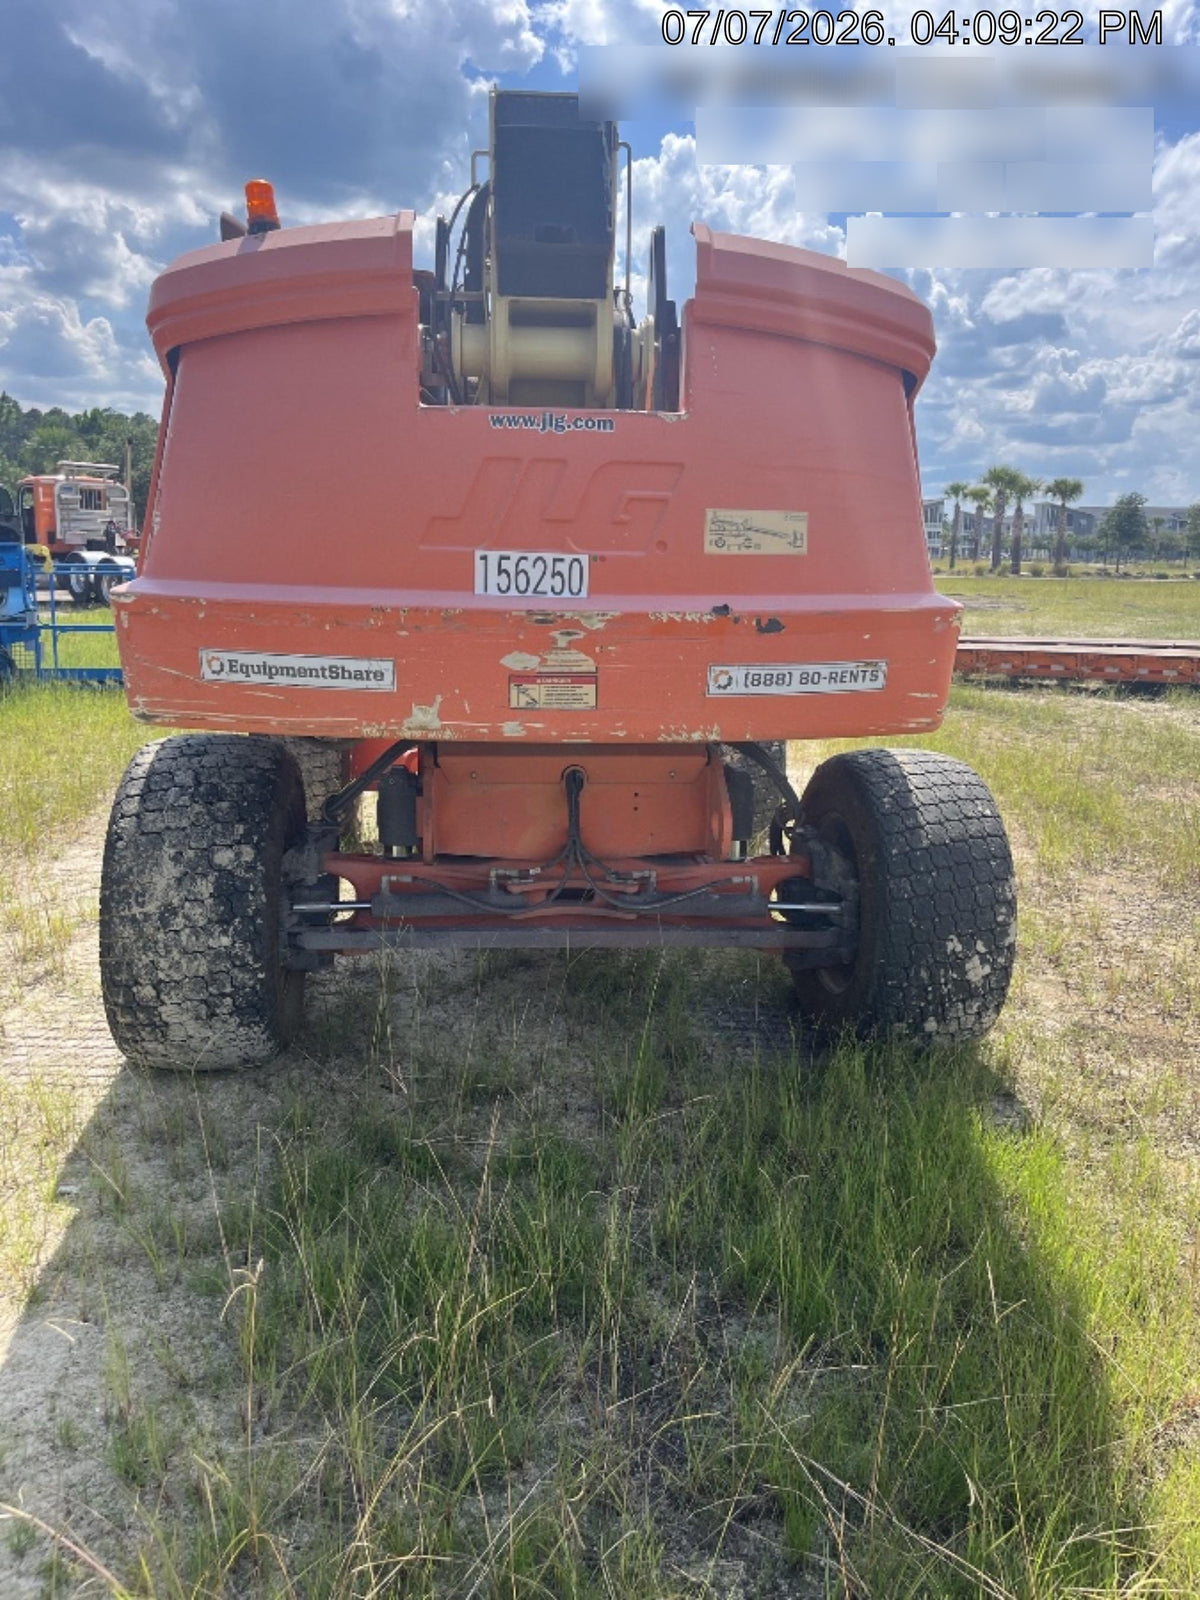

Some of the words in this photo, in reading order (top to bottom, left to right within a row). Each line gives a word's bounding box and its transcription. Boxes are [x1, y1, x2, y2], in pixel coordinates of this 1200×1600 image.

[489, 412, 614, 432] www.jlg.com
[479, 555, 584, 597] 156250
[227, 658, 385, 682] EquipmentShare
[799, 669, 880, 685] 80-RENTS
